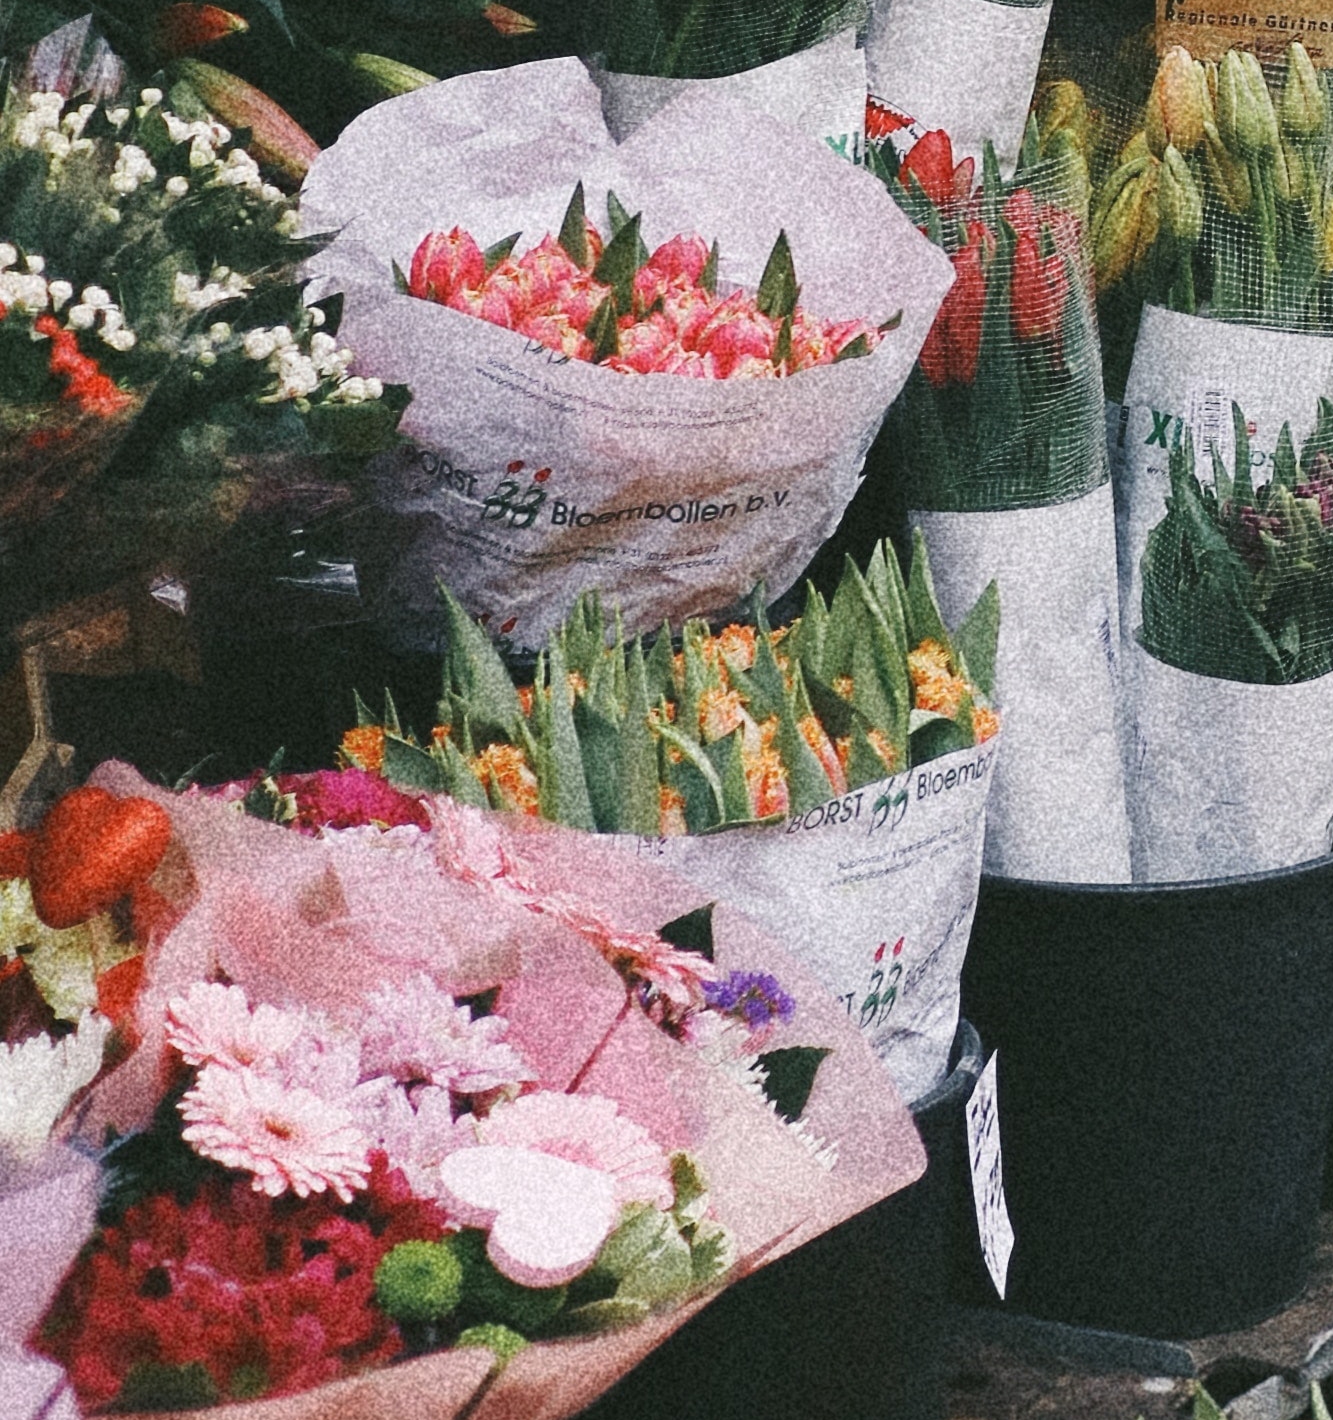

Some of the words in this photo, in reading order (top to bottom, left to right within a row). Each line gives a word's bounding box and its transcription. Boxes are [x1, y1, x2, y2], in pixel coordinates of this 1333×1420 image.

[1164, 9, 1258, 28] Regionale
[550, 500, 737, 529] Bloembollen
[786, 792, 863, 835] BORST
